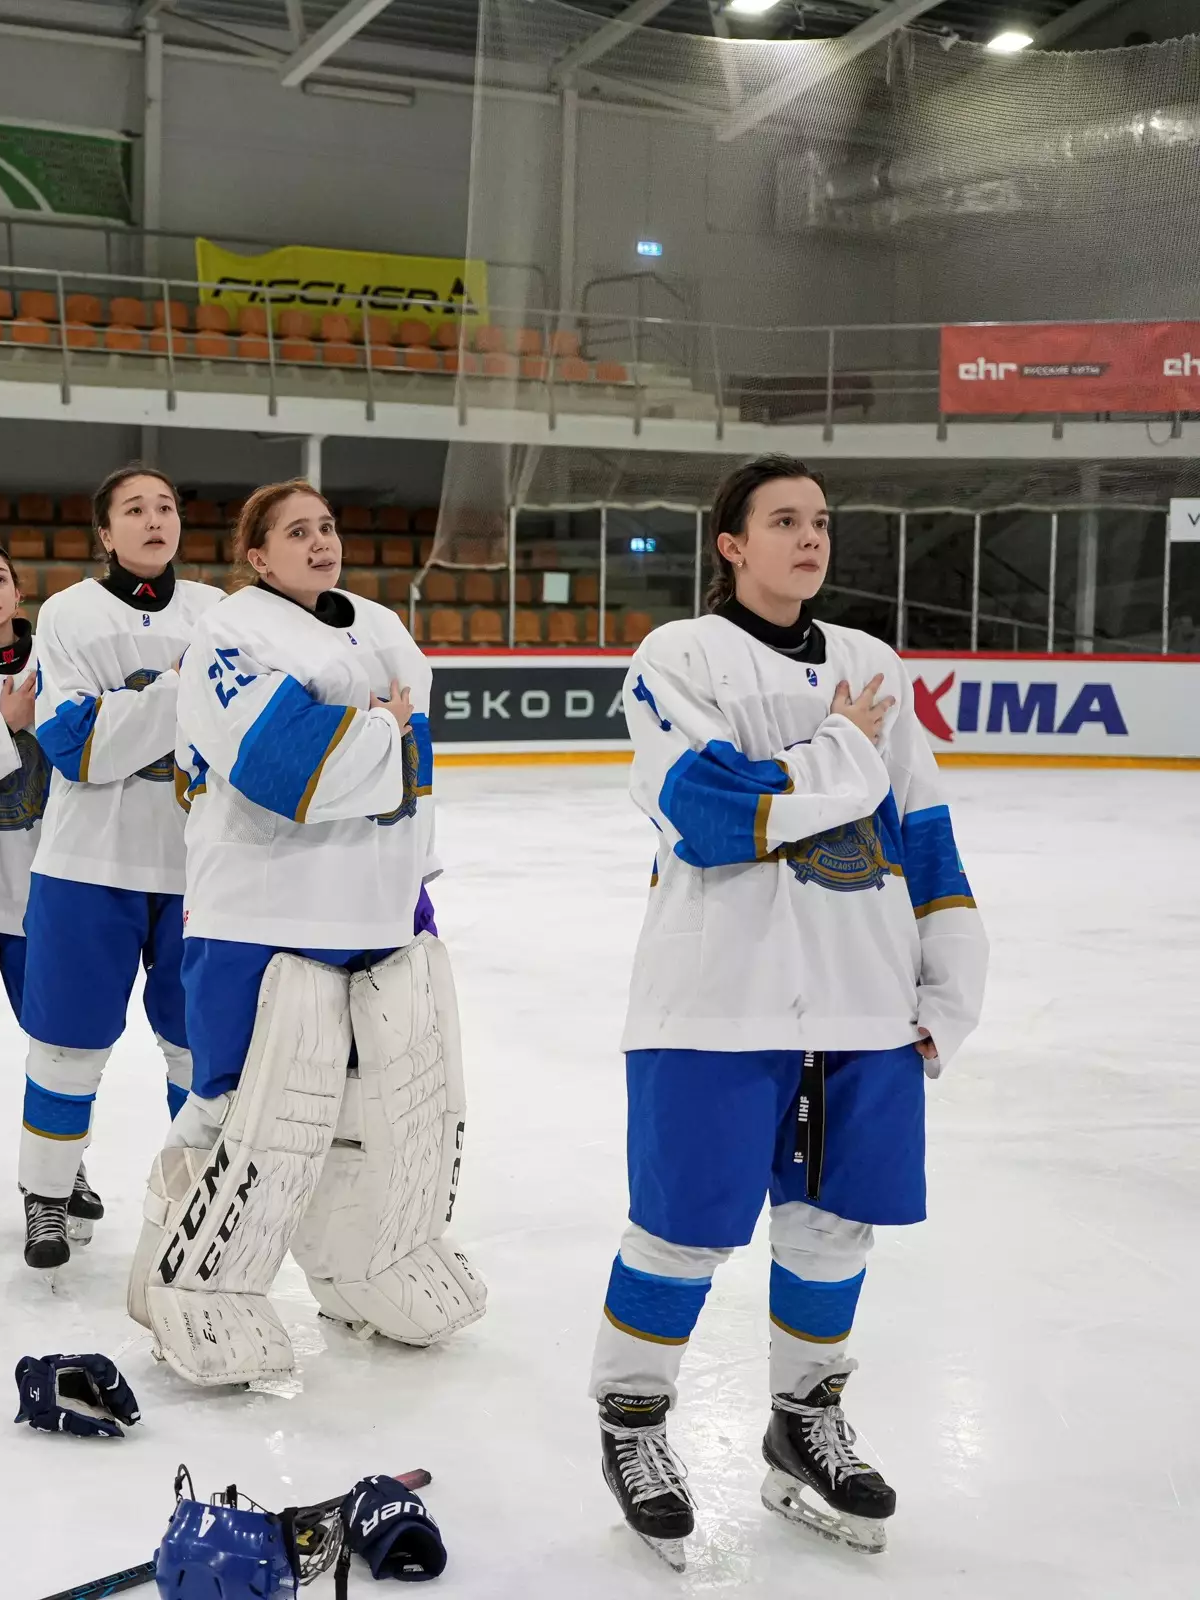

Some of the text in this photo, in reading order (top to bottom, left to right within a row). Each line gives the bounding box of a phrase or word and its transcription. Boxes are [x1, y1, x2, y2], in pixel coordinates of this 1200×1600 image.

[211, 277, 439, 313] FISCHER
[798, 1096, 809, 1122] IIHF
[157, 1140, 230, 1285] CCM
[196, 1161, 258, 1282] CCM
[198, 1507, 216, 1537] 4
